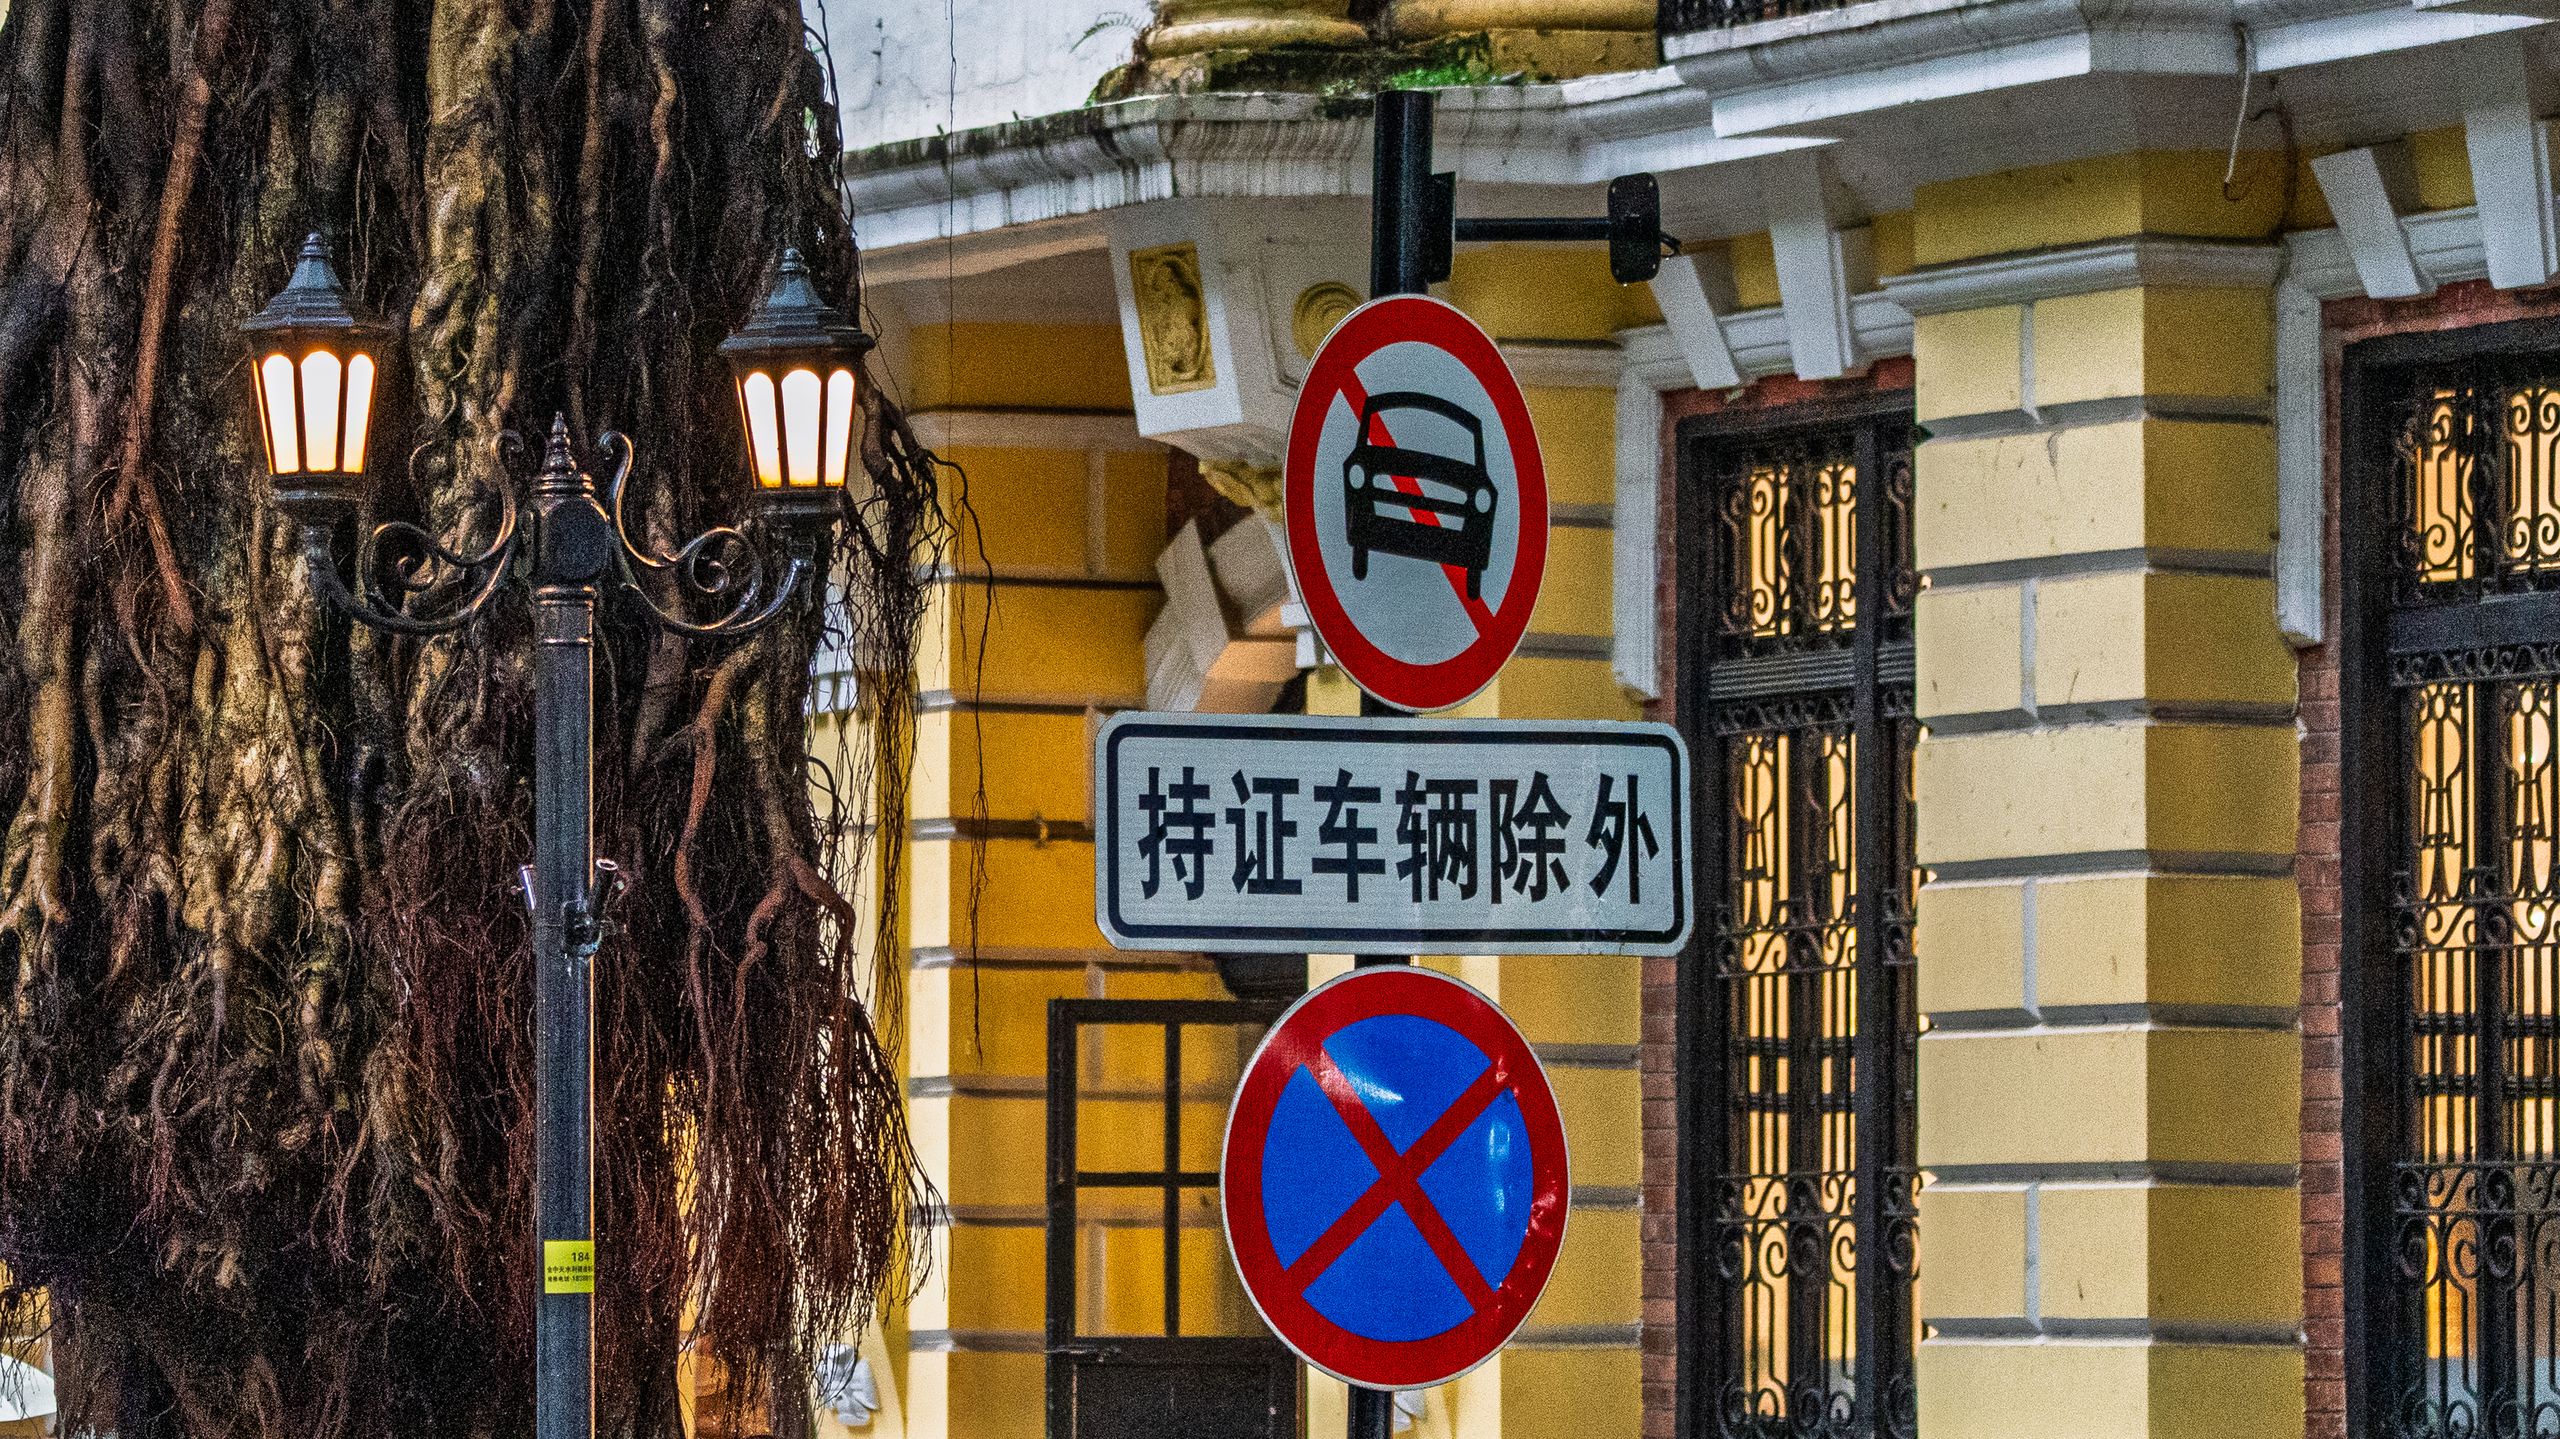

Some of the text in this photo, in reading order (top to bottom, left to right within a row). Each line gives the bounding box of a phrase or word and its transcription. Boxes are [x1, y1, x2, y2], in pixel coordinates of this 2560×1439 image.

[1137, 766, 1659, 905] 持证车辆除外
[571, 1252, 590, 1262] 184
